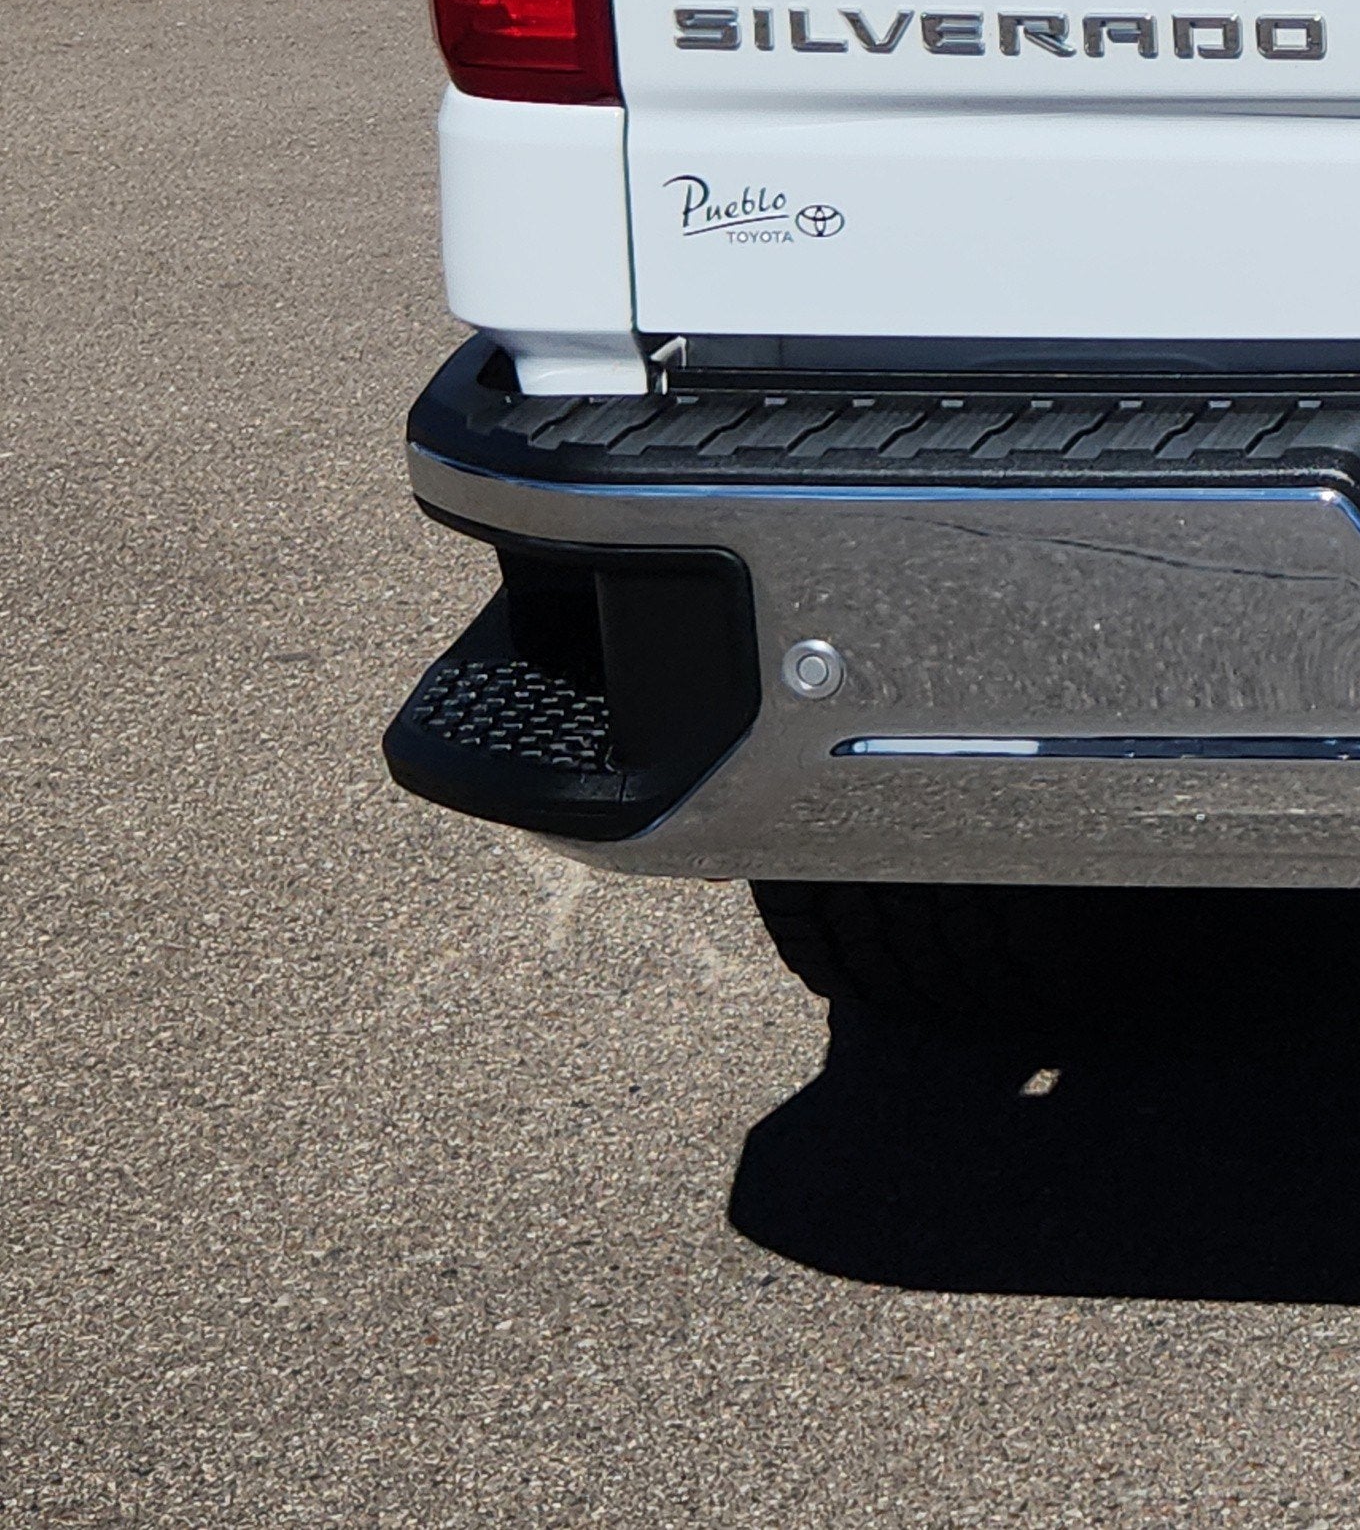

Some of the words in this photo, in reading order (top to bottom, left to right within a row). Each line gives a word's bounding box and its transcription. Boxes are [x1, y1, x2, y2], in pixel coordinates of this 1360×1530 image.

[673, 7, 1329, 61] SILVERADO
[663, 175, 788, 228] Pueblo
[726, 231, 794, 244] TOYOTA
